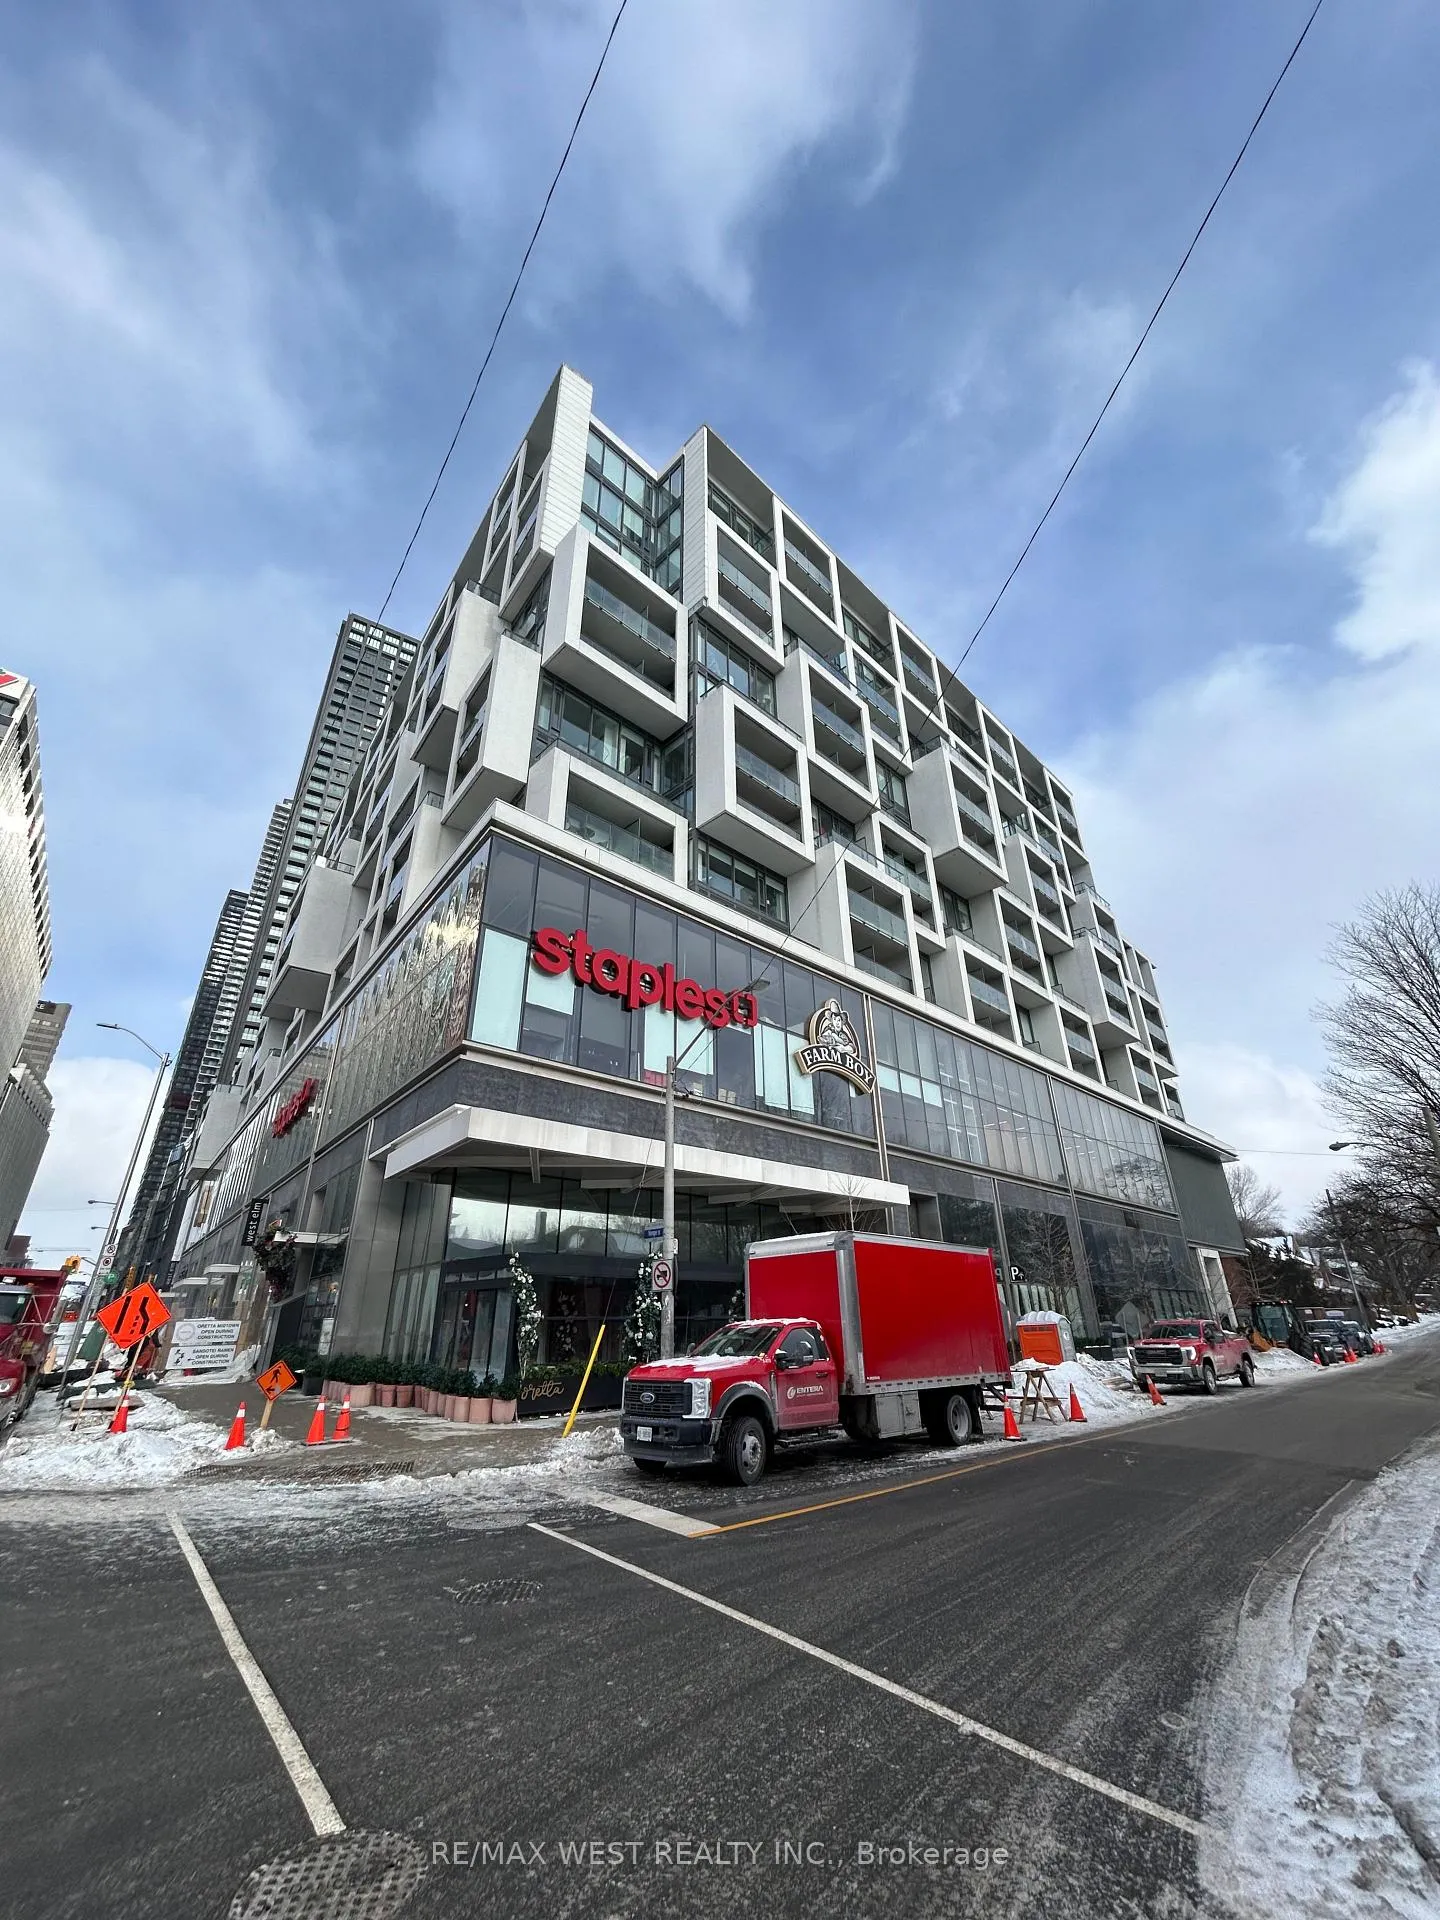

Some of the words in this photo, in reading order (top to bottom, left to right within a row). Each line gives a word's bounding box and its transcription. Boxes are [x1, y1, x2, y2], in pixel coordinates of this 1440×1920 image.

[532, 927, 731, 1028] staples
[803, 1047, 842, 1066] FARM
[845, 1054, 873, 1083] BOY
[251, 1202, 262, 1219] elm
[246, 1220, 258, 1242] west
[1010, 1266, 1019, 1281] P
